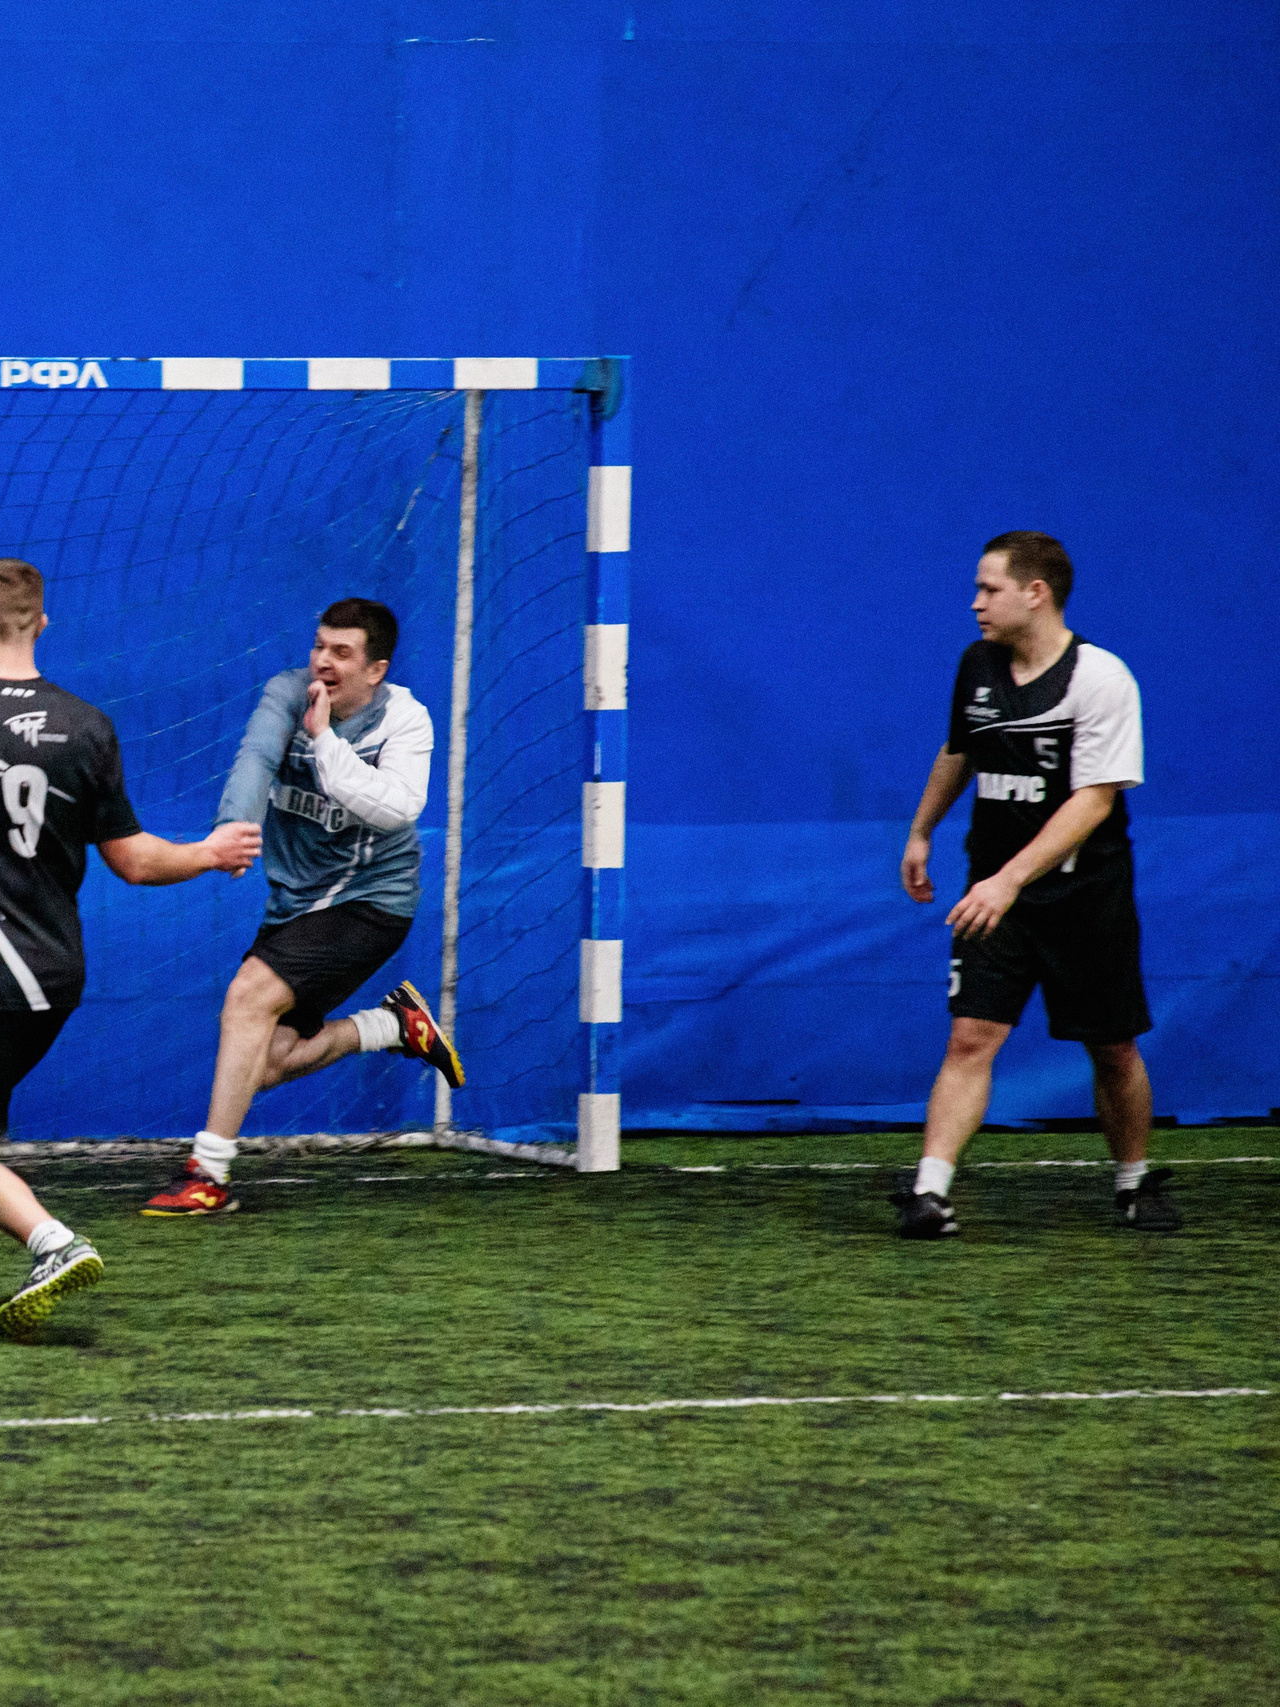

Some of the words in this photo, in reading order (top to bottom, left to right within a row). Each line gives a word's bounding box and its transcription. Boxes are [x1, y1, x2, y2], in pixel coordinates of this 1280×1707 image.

[0, 360, 109, 388] РФЛ
[1034, 737, 1060, 770] 5
[1, 764, 49, 859] 9
[287, 787, 345, 832] ПАРС
